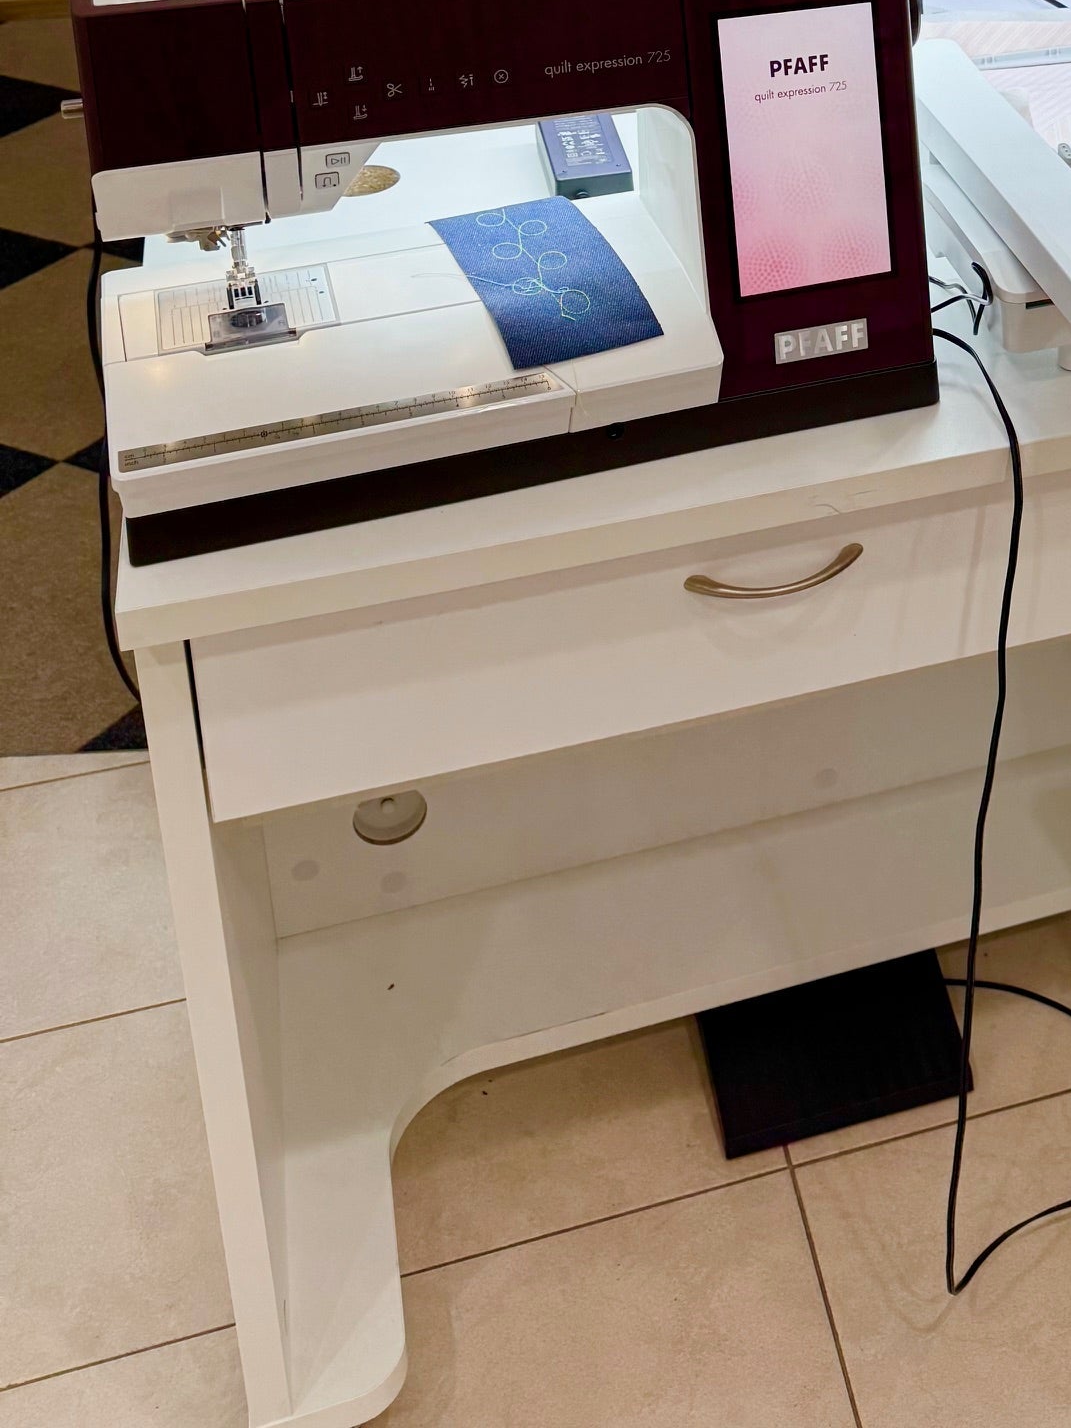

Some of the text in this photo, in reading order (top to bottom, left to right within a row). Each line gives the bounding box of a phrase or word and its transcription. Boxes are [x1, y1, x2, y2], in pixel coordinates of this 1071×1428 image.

[544, 49, 671, 78] quilt expression 725
[769, 54, 829, 78] PFAFF
[754, 80, 848, 103] quilt expression 725
[778, 322, 864, 360] PFAFF
